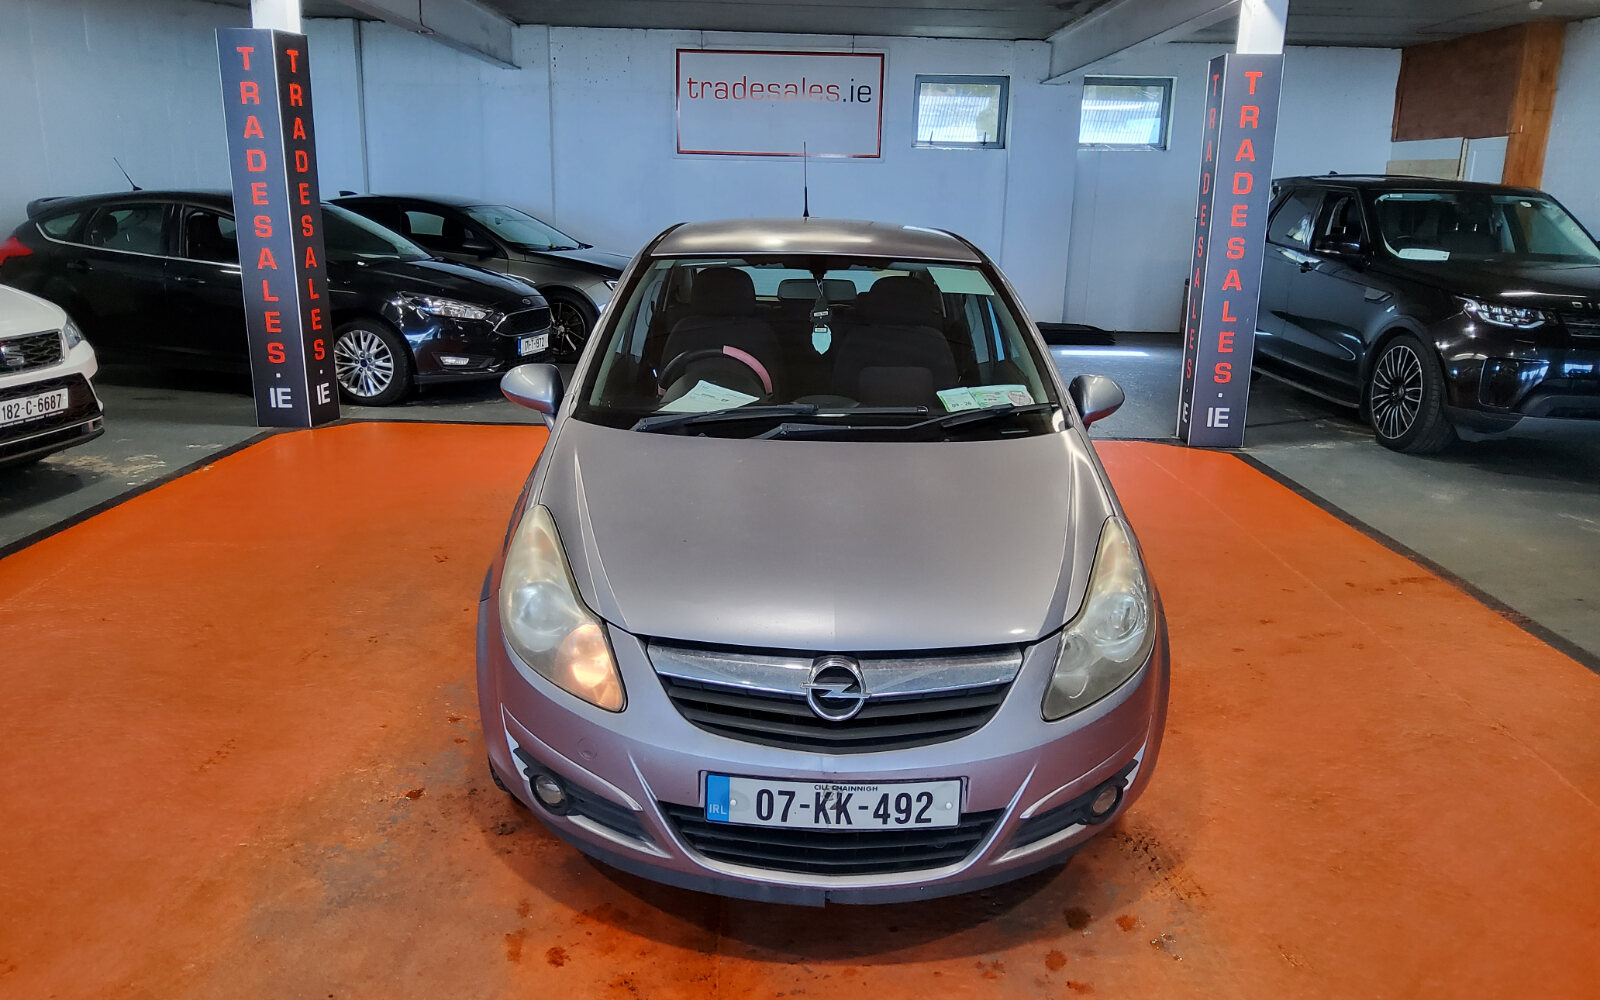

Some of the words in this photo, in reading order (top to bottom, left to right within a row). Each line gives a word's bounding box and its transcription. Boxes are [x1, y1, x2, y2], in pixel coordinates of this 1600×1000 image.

[687, 75, 872, 103] tradesales.ie
[2, 393, 62, 420] 182-C-6687
[709, 803, 727, 815] IRL
[755, 788, 934, 825] 07-KK-492
